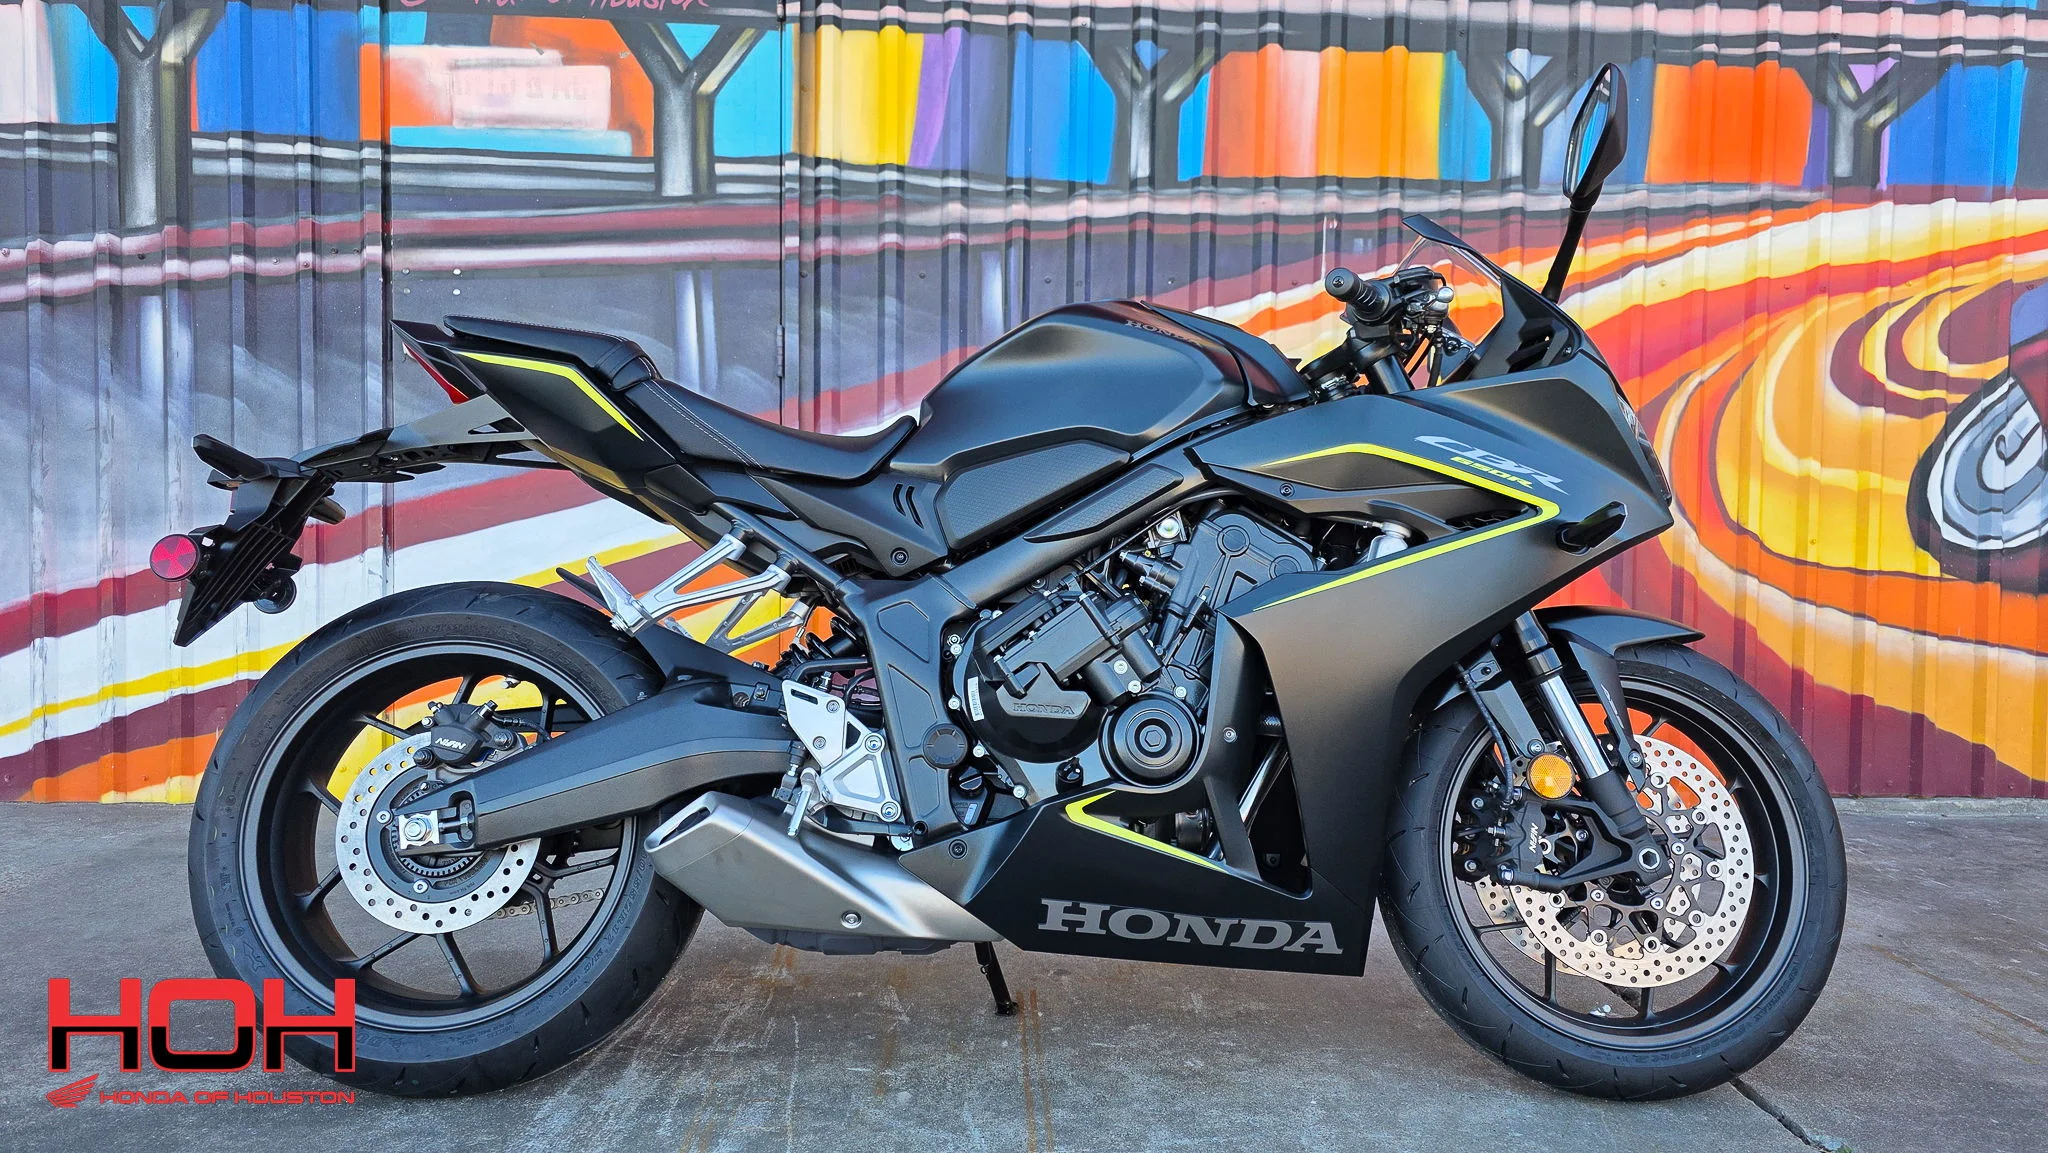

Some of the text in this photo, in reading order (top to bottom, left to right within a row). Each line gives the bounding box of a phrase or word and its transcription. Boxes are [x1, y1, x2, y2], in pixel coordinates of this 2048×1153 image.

[1414, 435, 1569, 495] CBR
[1450, 456, 1534, 489] 650R
[1013, 703, 1075, 715] HONDA
[1038, 898, 1344, 955] HONDA
